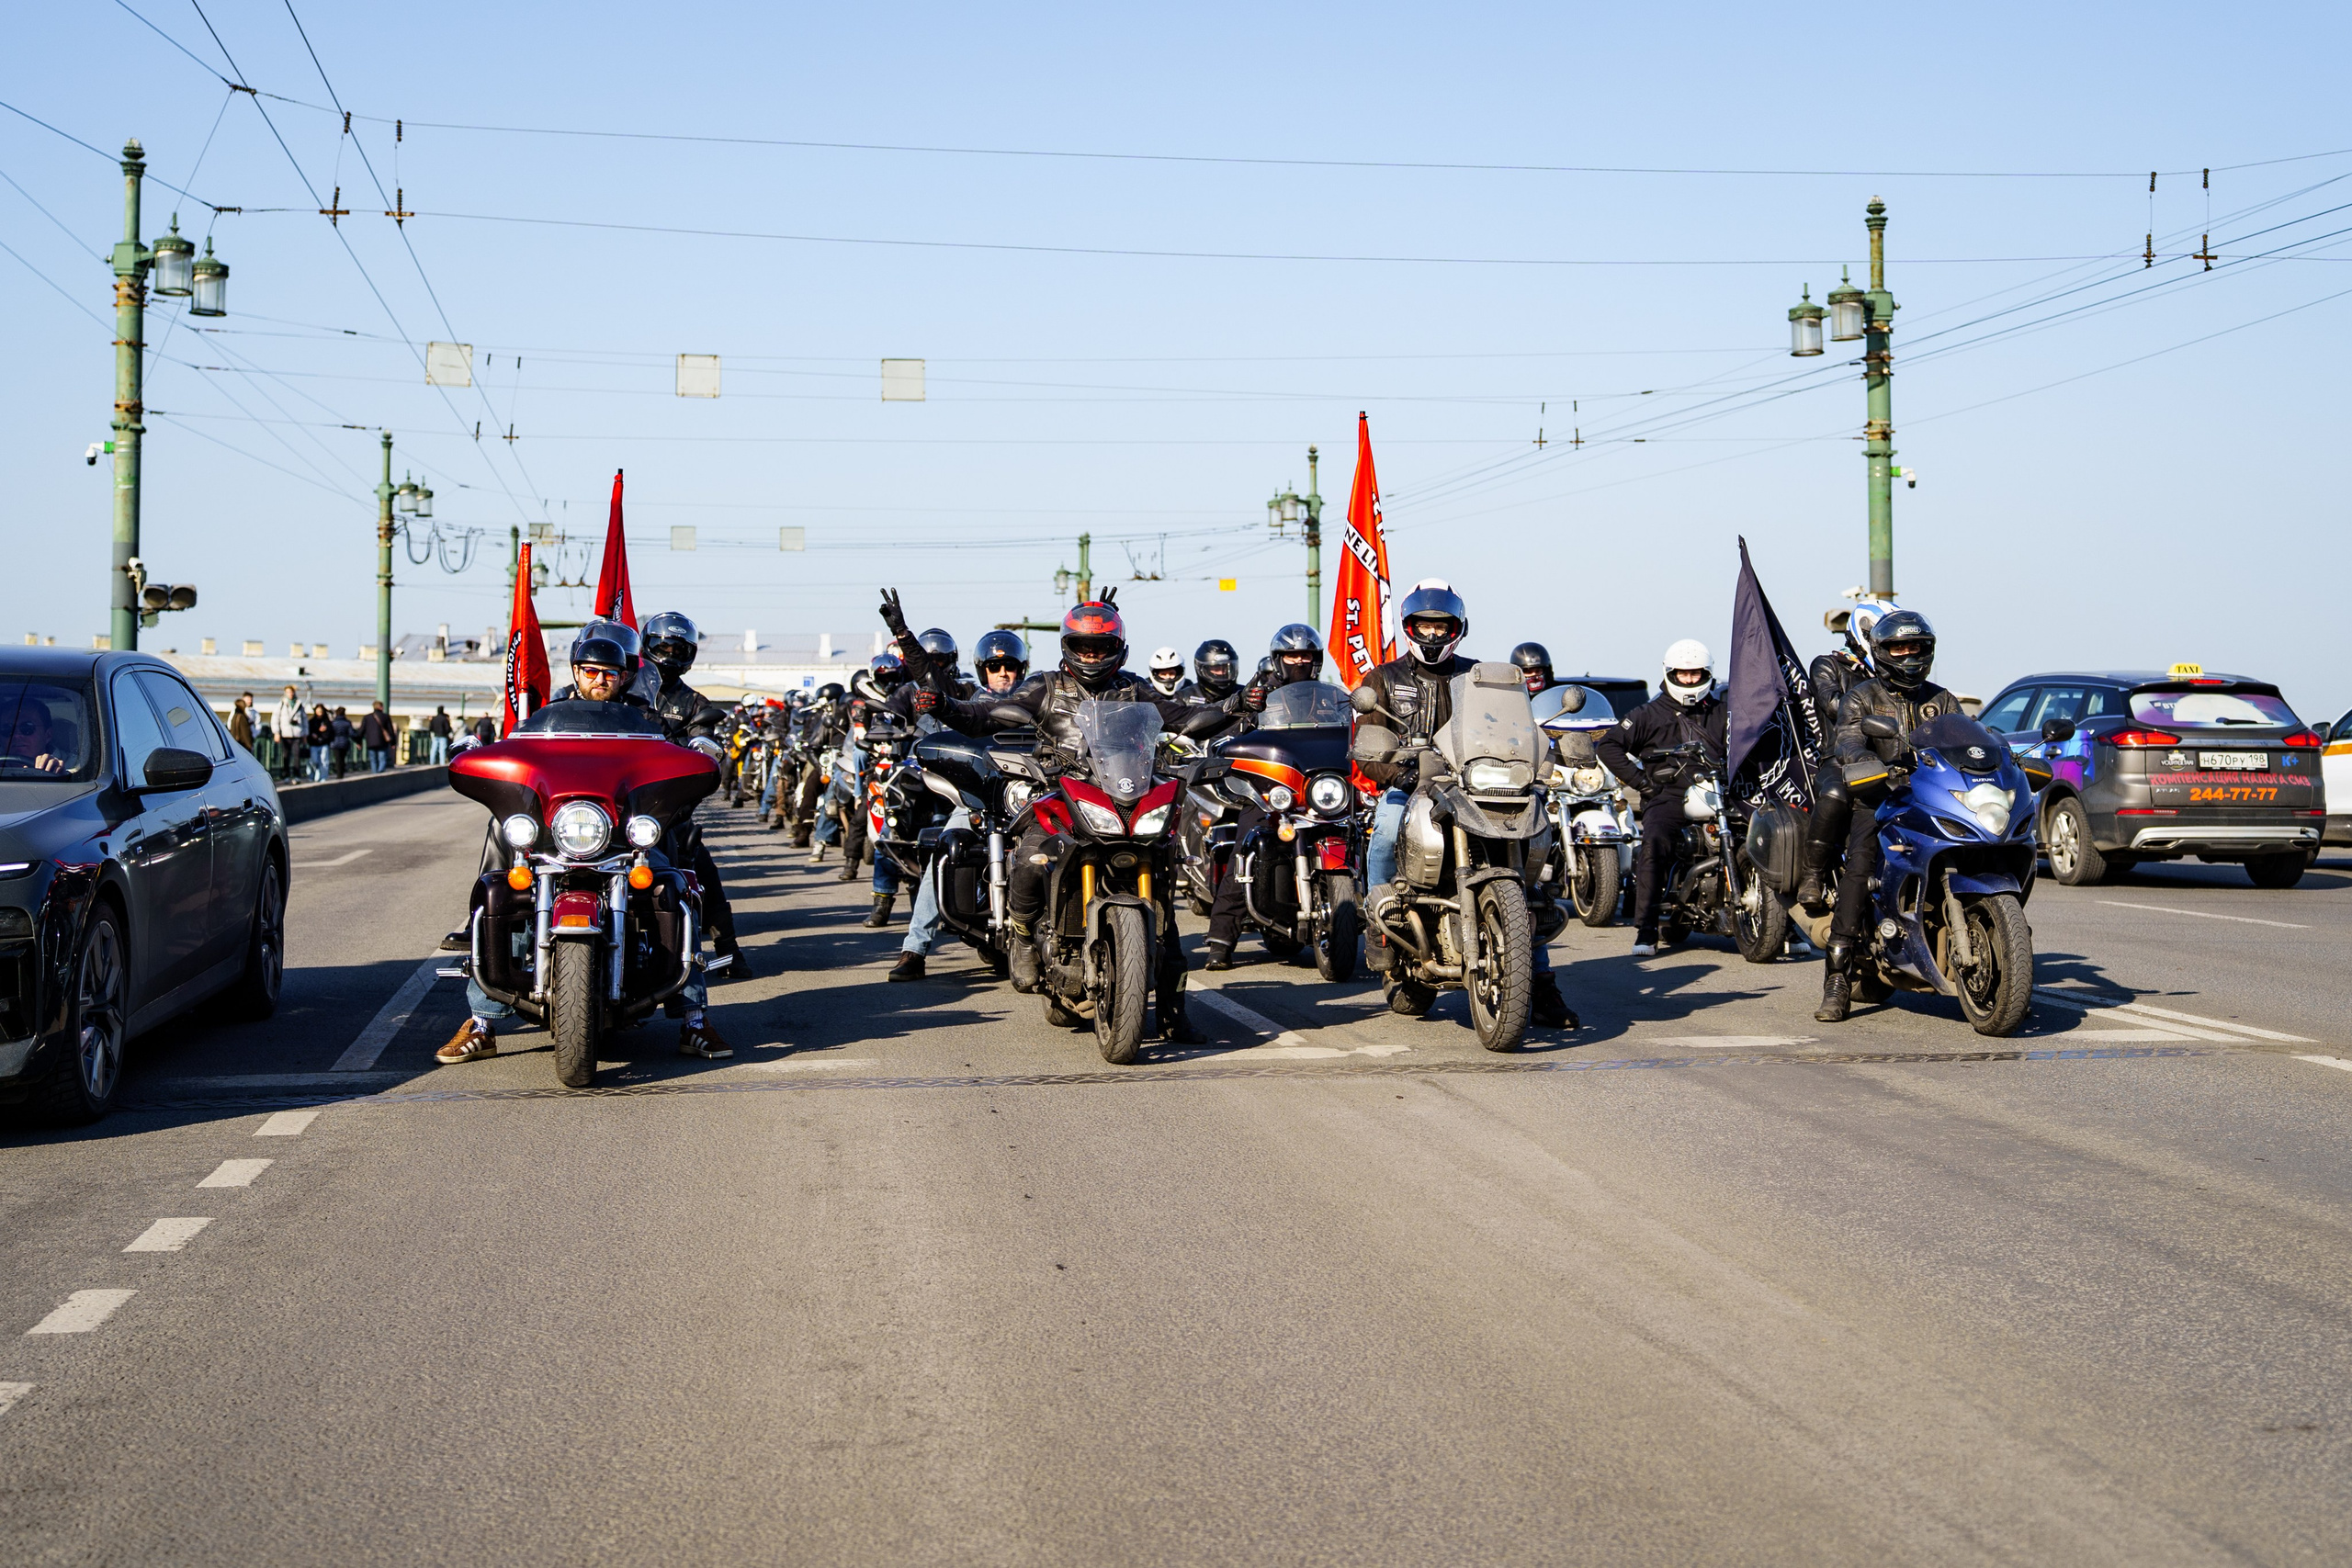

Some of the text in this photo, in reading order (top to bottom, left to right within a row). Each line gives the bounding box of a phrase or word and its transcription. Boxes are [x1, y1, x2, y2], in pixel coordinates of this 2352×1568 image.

[1346, 598, 1361, 630] ST.
[2176, 665, 2199, 673] TAXI
[508, 685, 518, 712] THE
[2248, 754, 2265, 763] 198
[2149, 772, 2312, 786] КОМПЕНСАЦИЯ НАЛОГА СМЗ
[1779, 781, 1801, 804] MC
[2189, 787, 2278, 801] 244-77-77
